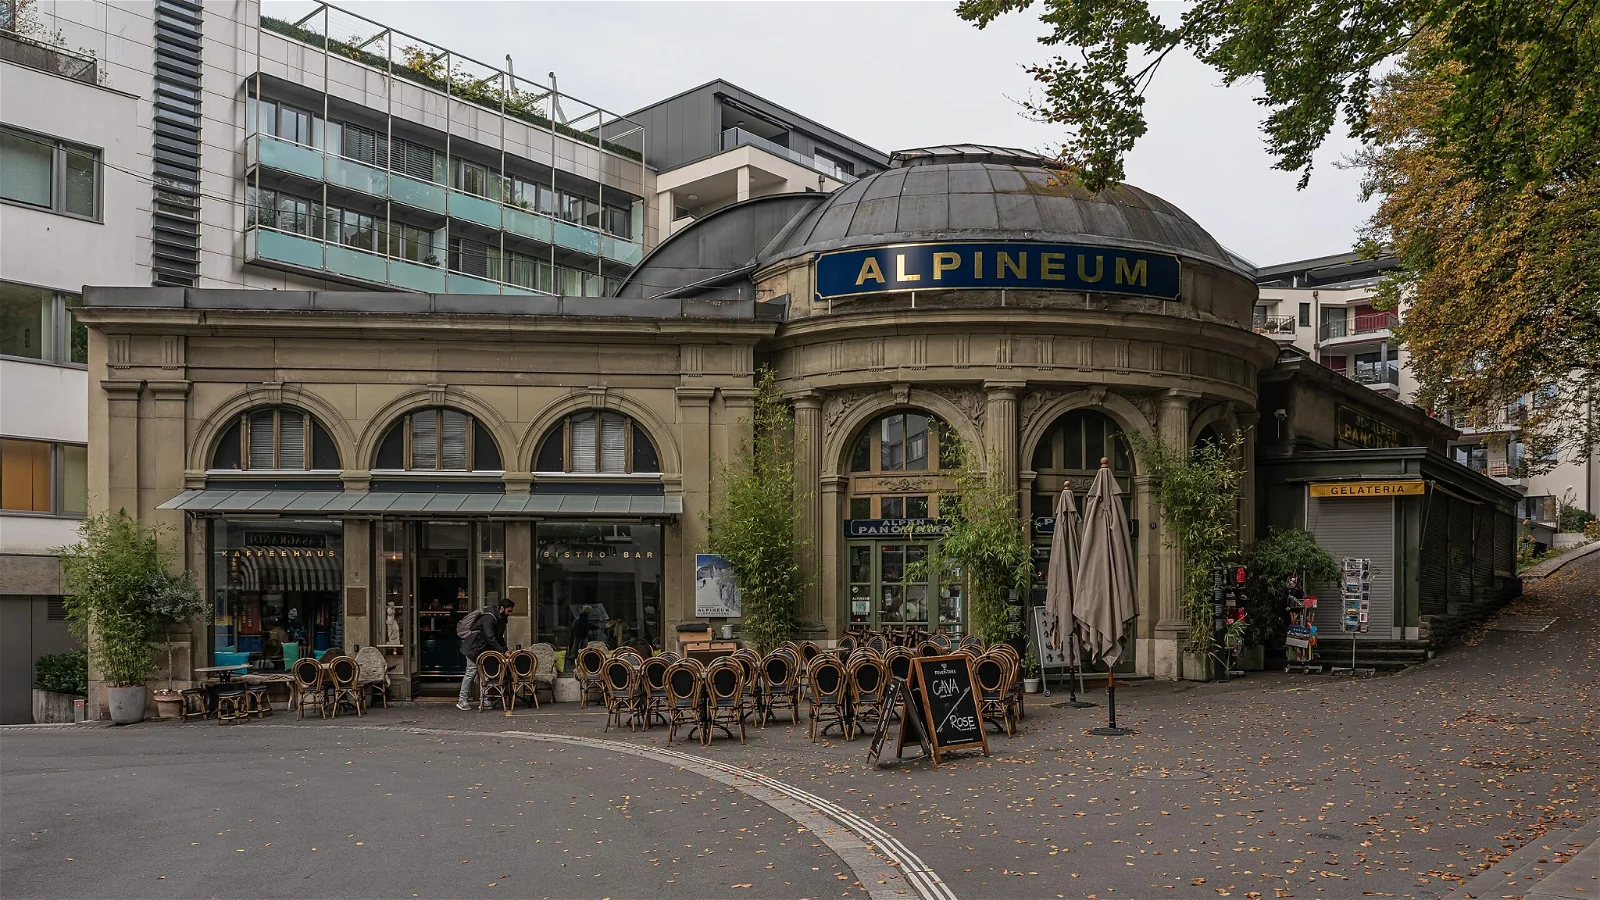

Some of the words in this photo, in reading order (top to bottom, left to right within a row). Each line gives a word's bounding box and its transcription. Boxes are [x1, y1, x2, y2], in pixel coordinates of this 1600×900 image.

[854, 250, 1148, 287] ALPINEUM
[1344, 424, 1399, 448] PANORAM
[1370, 423, 1397, 441] ALPEN
[1330, 484, 1405, 495] GELATERIA
[543, 551, 606, 559] BISTRO
[623, 551, 653, 559] BAR
[932, 678, 960, 697] CAVA
